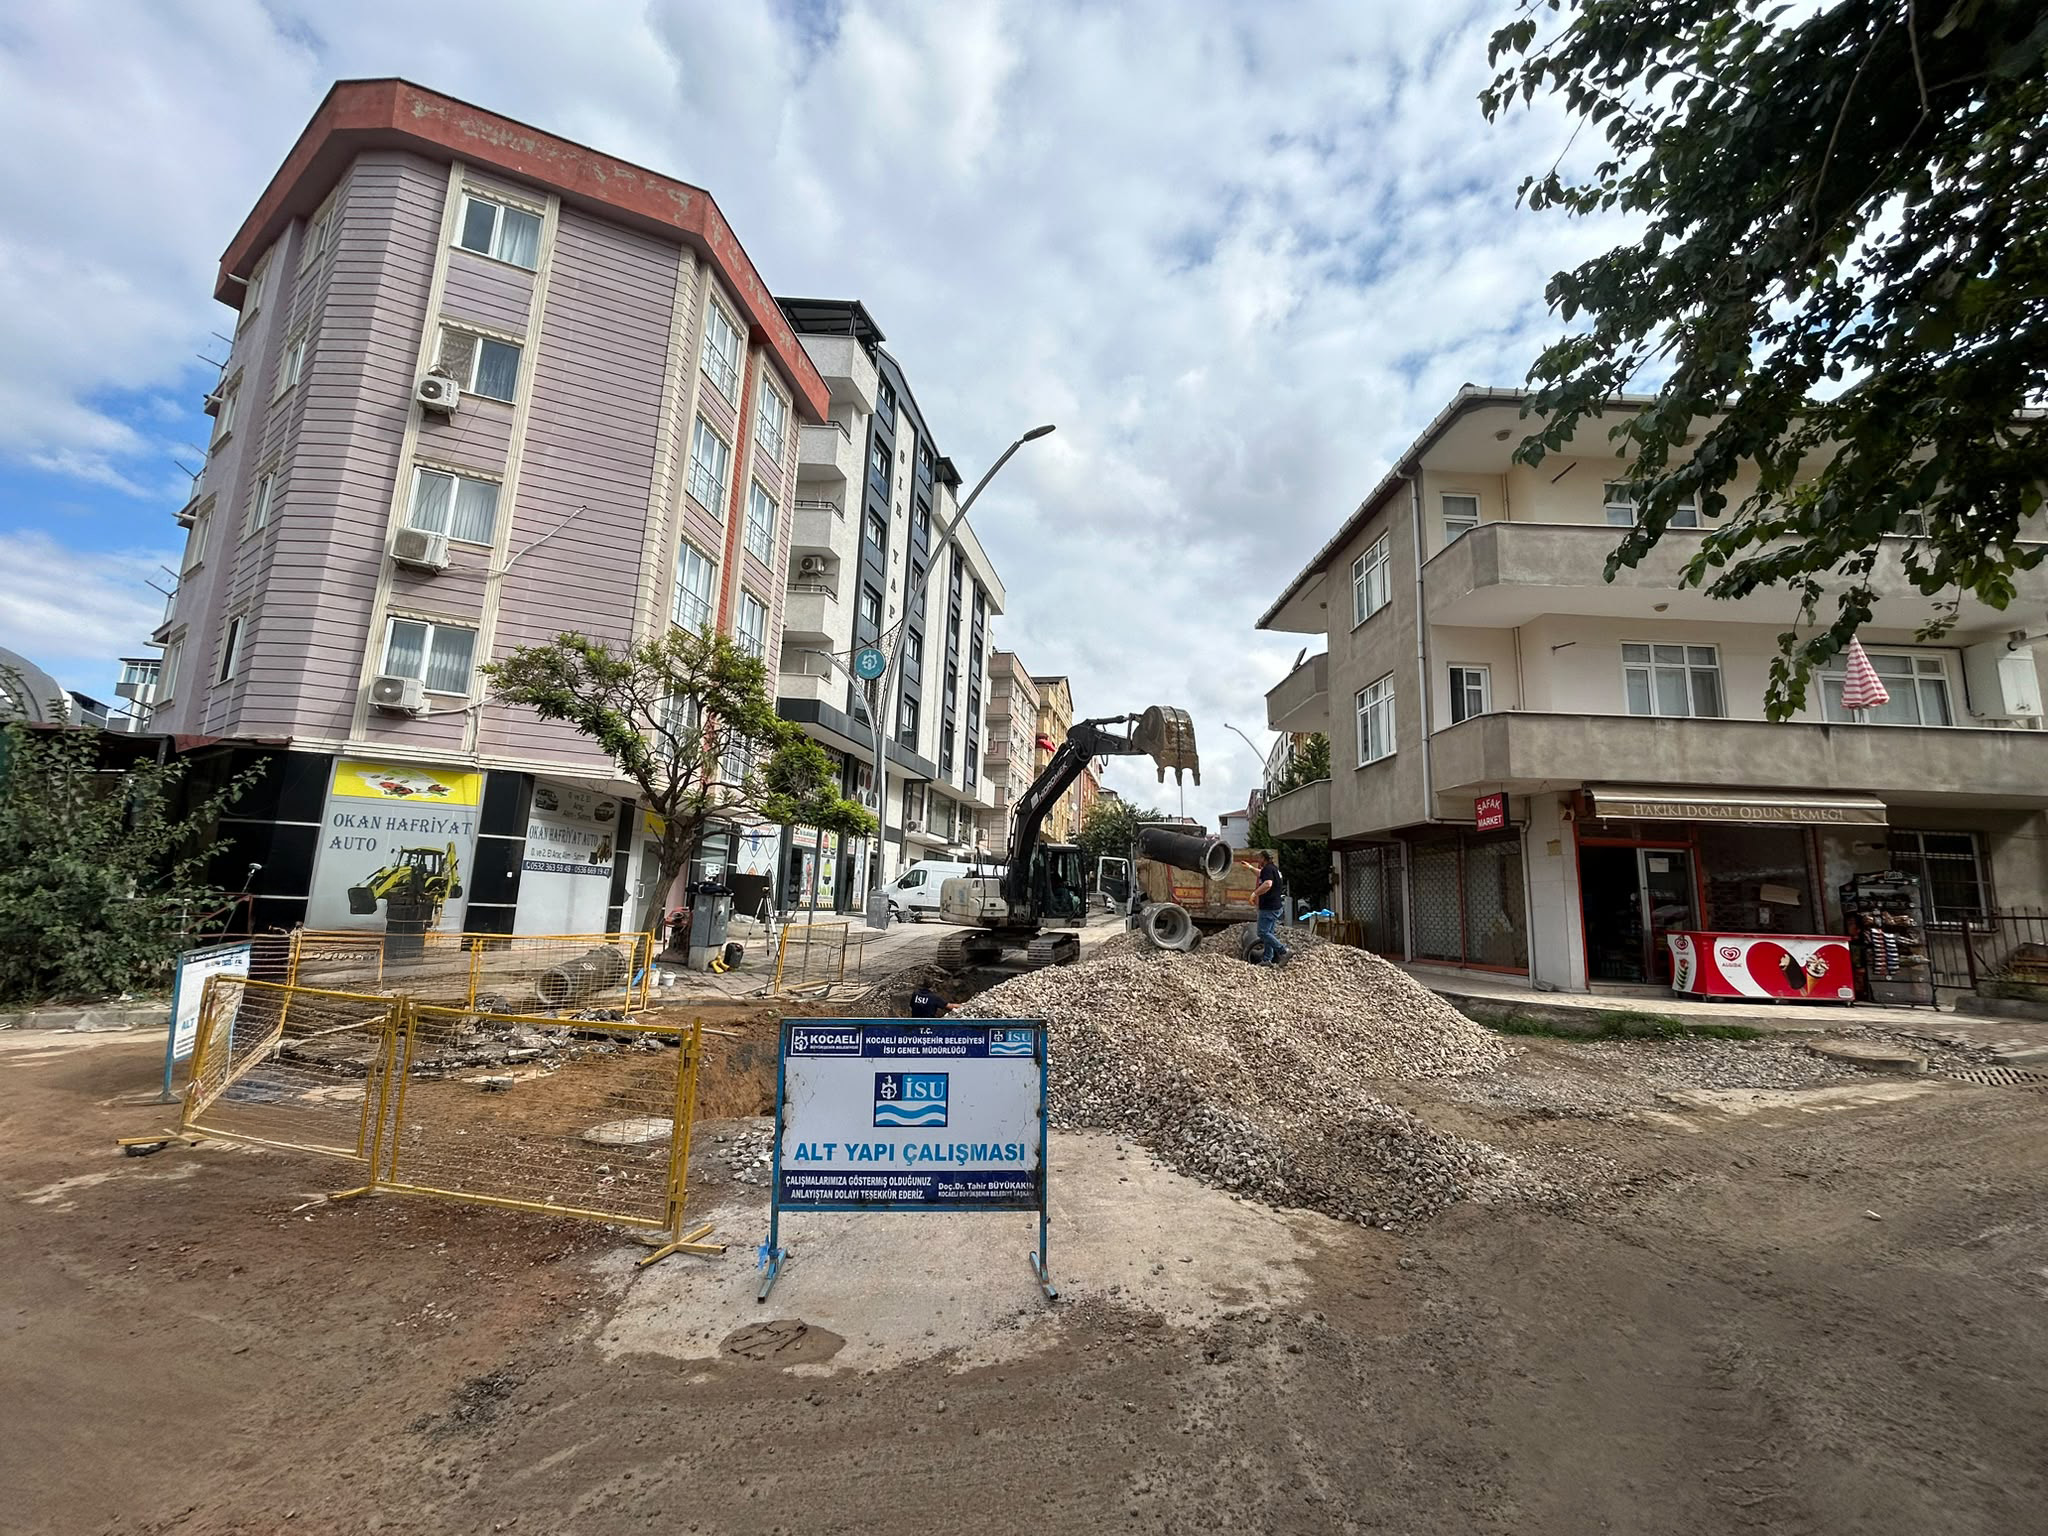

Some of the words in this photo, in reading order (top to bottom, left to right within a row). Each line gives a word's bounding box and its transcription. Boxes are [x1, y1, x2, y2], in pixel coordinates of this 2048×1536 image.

[1477, 799, 1501, 815] ŞAFAK
[1739, 807, 1784, 819] ODUN
[333, 813, 382, 830] OKAN
[386, 817, 473, 835] HAFRİYAT
[1478, 814, 1503, 827] MARKET
[529, 825, 548, 840] OKAN
[329, 836, 377, 851] AUTO
[810, 1033, 860, 1044] KOCAELİ
[865, 1035, 897, 1044] KOCAELİ
[898, 1036, 943, 1046] BÜYÜKŞEHİR
[945, 1036, 985, 1045] BELEDİYESİ
[1007, 1030, 1031, 1042] İSU
[883, 1045, 896, 1054] İSU
[922, 1046, 967, 1055] MÜDÜRLÜĞÜ
[905, 1077, 945, 1099] İSU
[794, 1142, 838, 1161] ALT
[844, 1143, 895, 1161] YAPI
[902, 1143, 1025, 1166] ÇALIŞMASI
[785, 1175, 847, 1187] ÇALIŞMALARIMIZA
[889, 1175, 931, 1186] OLDUĞUNUZ
[938, 1182, 966, 1191] Doç.Dr.
[967, 1182, 987, 1190] Tahir
[791, 1189, 833, 1200] ANLAYIŞTAN
[834, 1189, 860, 1199] DOLAYI
[861, 1188, 897, 1200] TEŞEKKÜR
[898, 1188, 925, 1199] EDERİZ.
